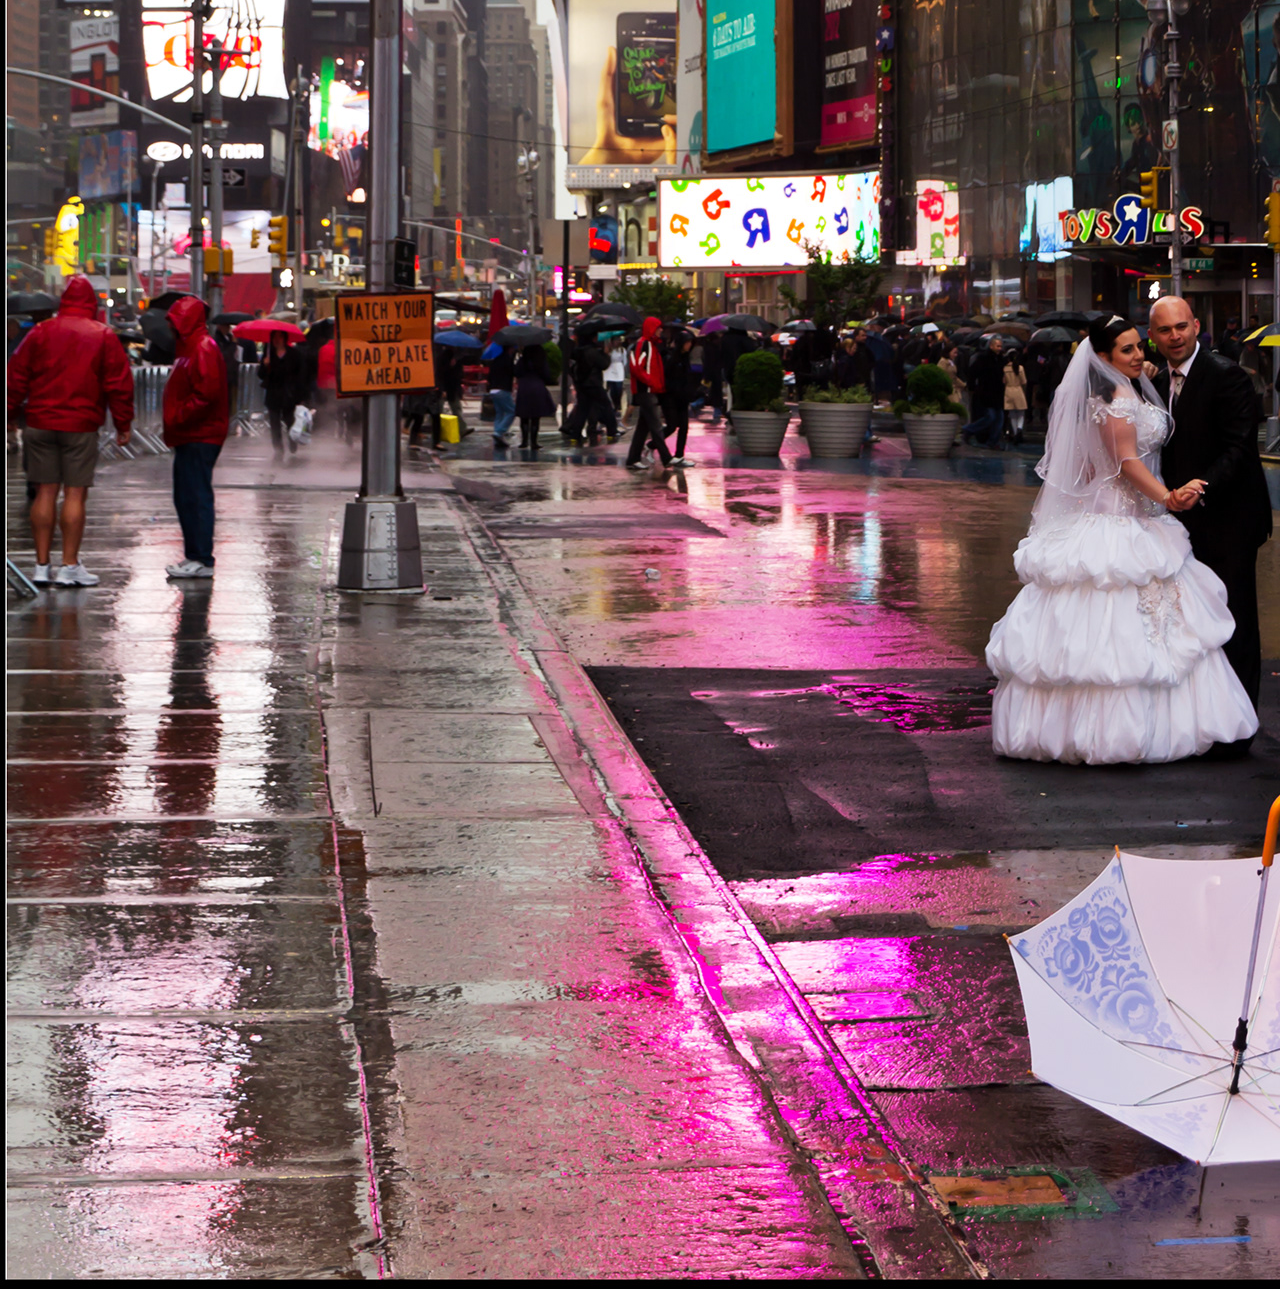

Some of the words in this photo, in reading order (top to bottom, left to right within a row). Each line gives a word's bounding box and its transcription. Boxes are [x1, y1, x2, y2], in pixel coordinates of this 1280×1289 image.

[343, 301, 388, 321] WATCH
[394, 299, 427, 319] YOUR
[371, 323, 402, 342] STEP
[344, 347, 381, 366] ROAD
[387, 344, 429, 364] PLATE
[365, 366, 412, 386] AHEAD
